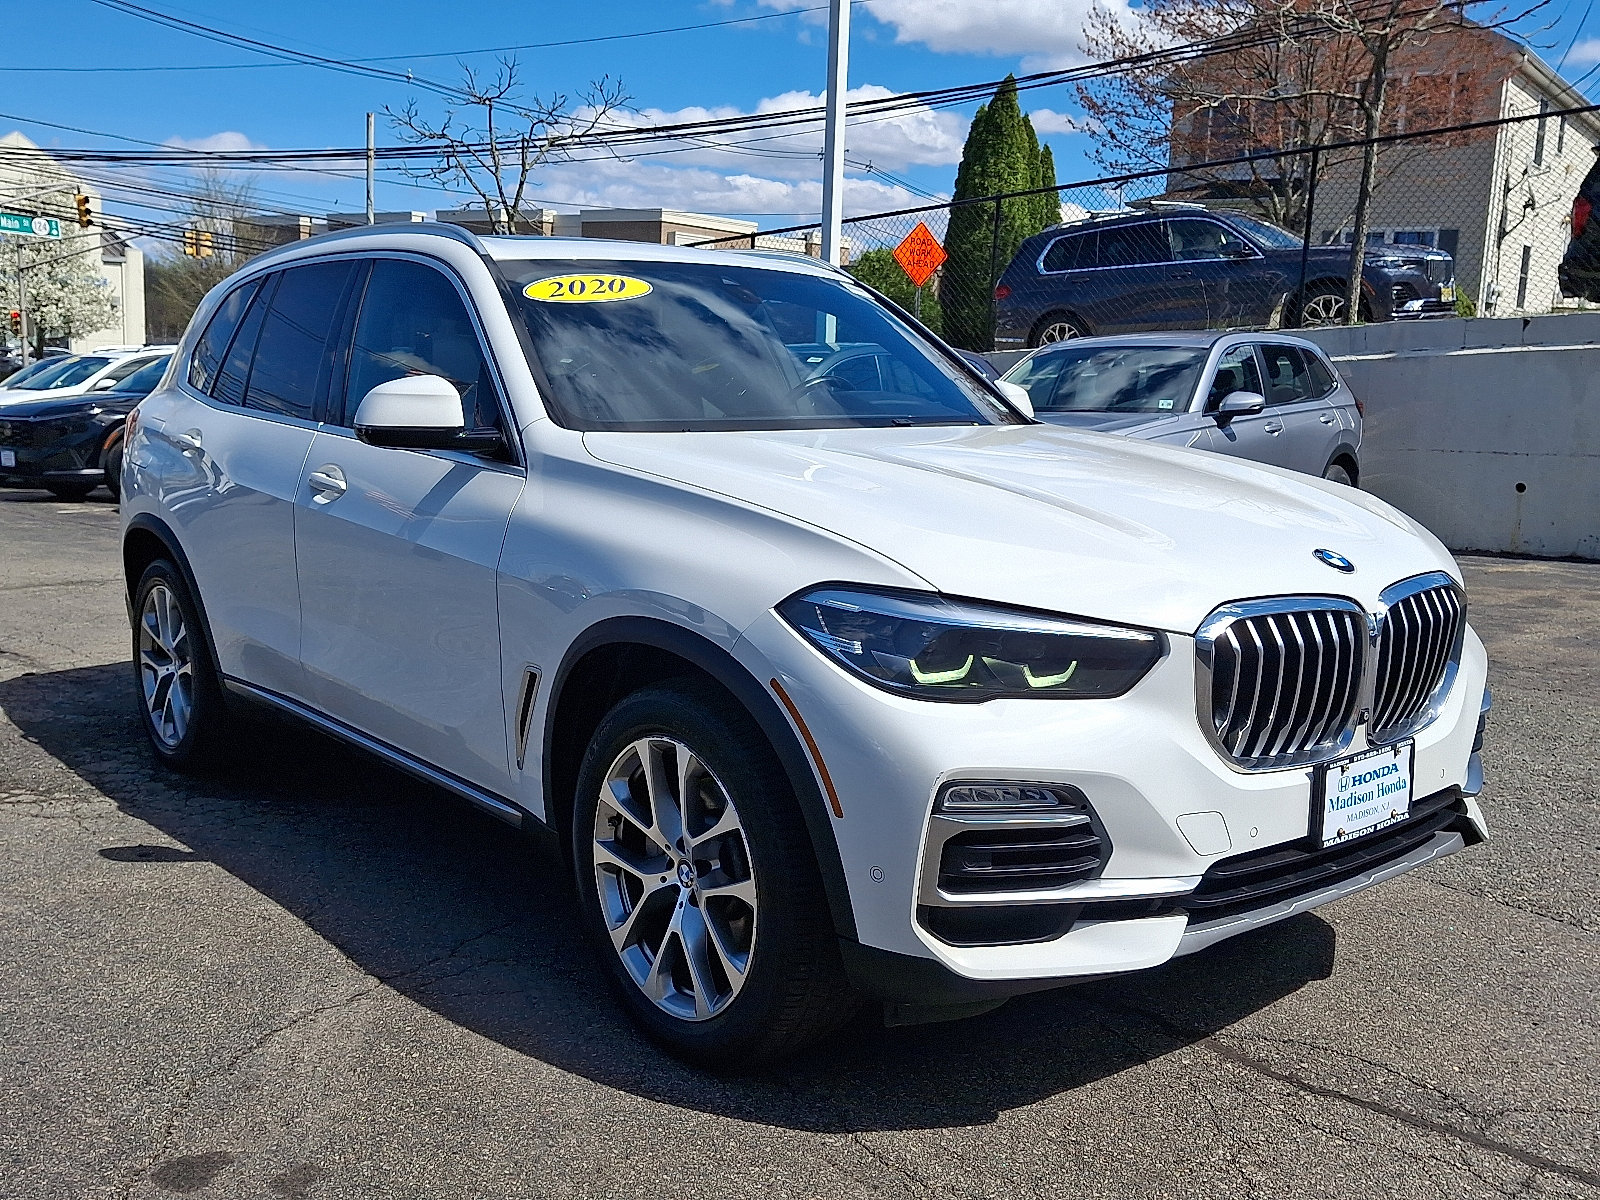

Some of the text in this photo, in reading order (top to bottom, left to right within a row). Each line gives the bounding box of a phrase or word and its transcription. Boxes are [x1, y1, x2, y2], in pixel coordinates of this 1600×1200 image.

[0, 215, 20, 229] Main
[34, 220, 47, 232] 124
[910, 237, 932, 246] ROAD
[909, 248, 931, 257] WORK
[907, 259, 934, 269] AHEAD
[548, 278, 626, 298] 2020
[1351, 763, 1400, 788] HONDA
[1328, 776, 1407, 814] Madison Honda
[1323, 812, 1410, 848] MADISON HONDA
